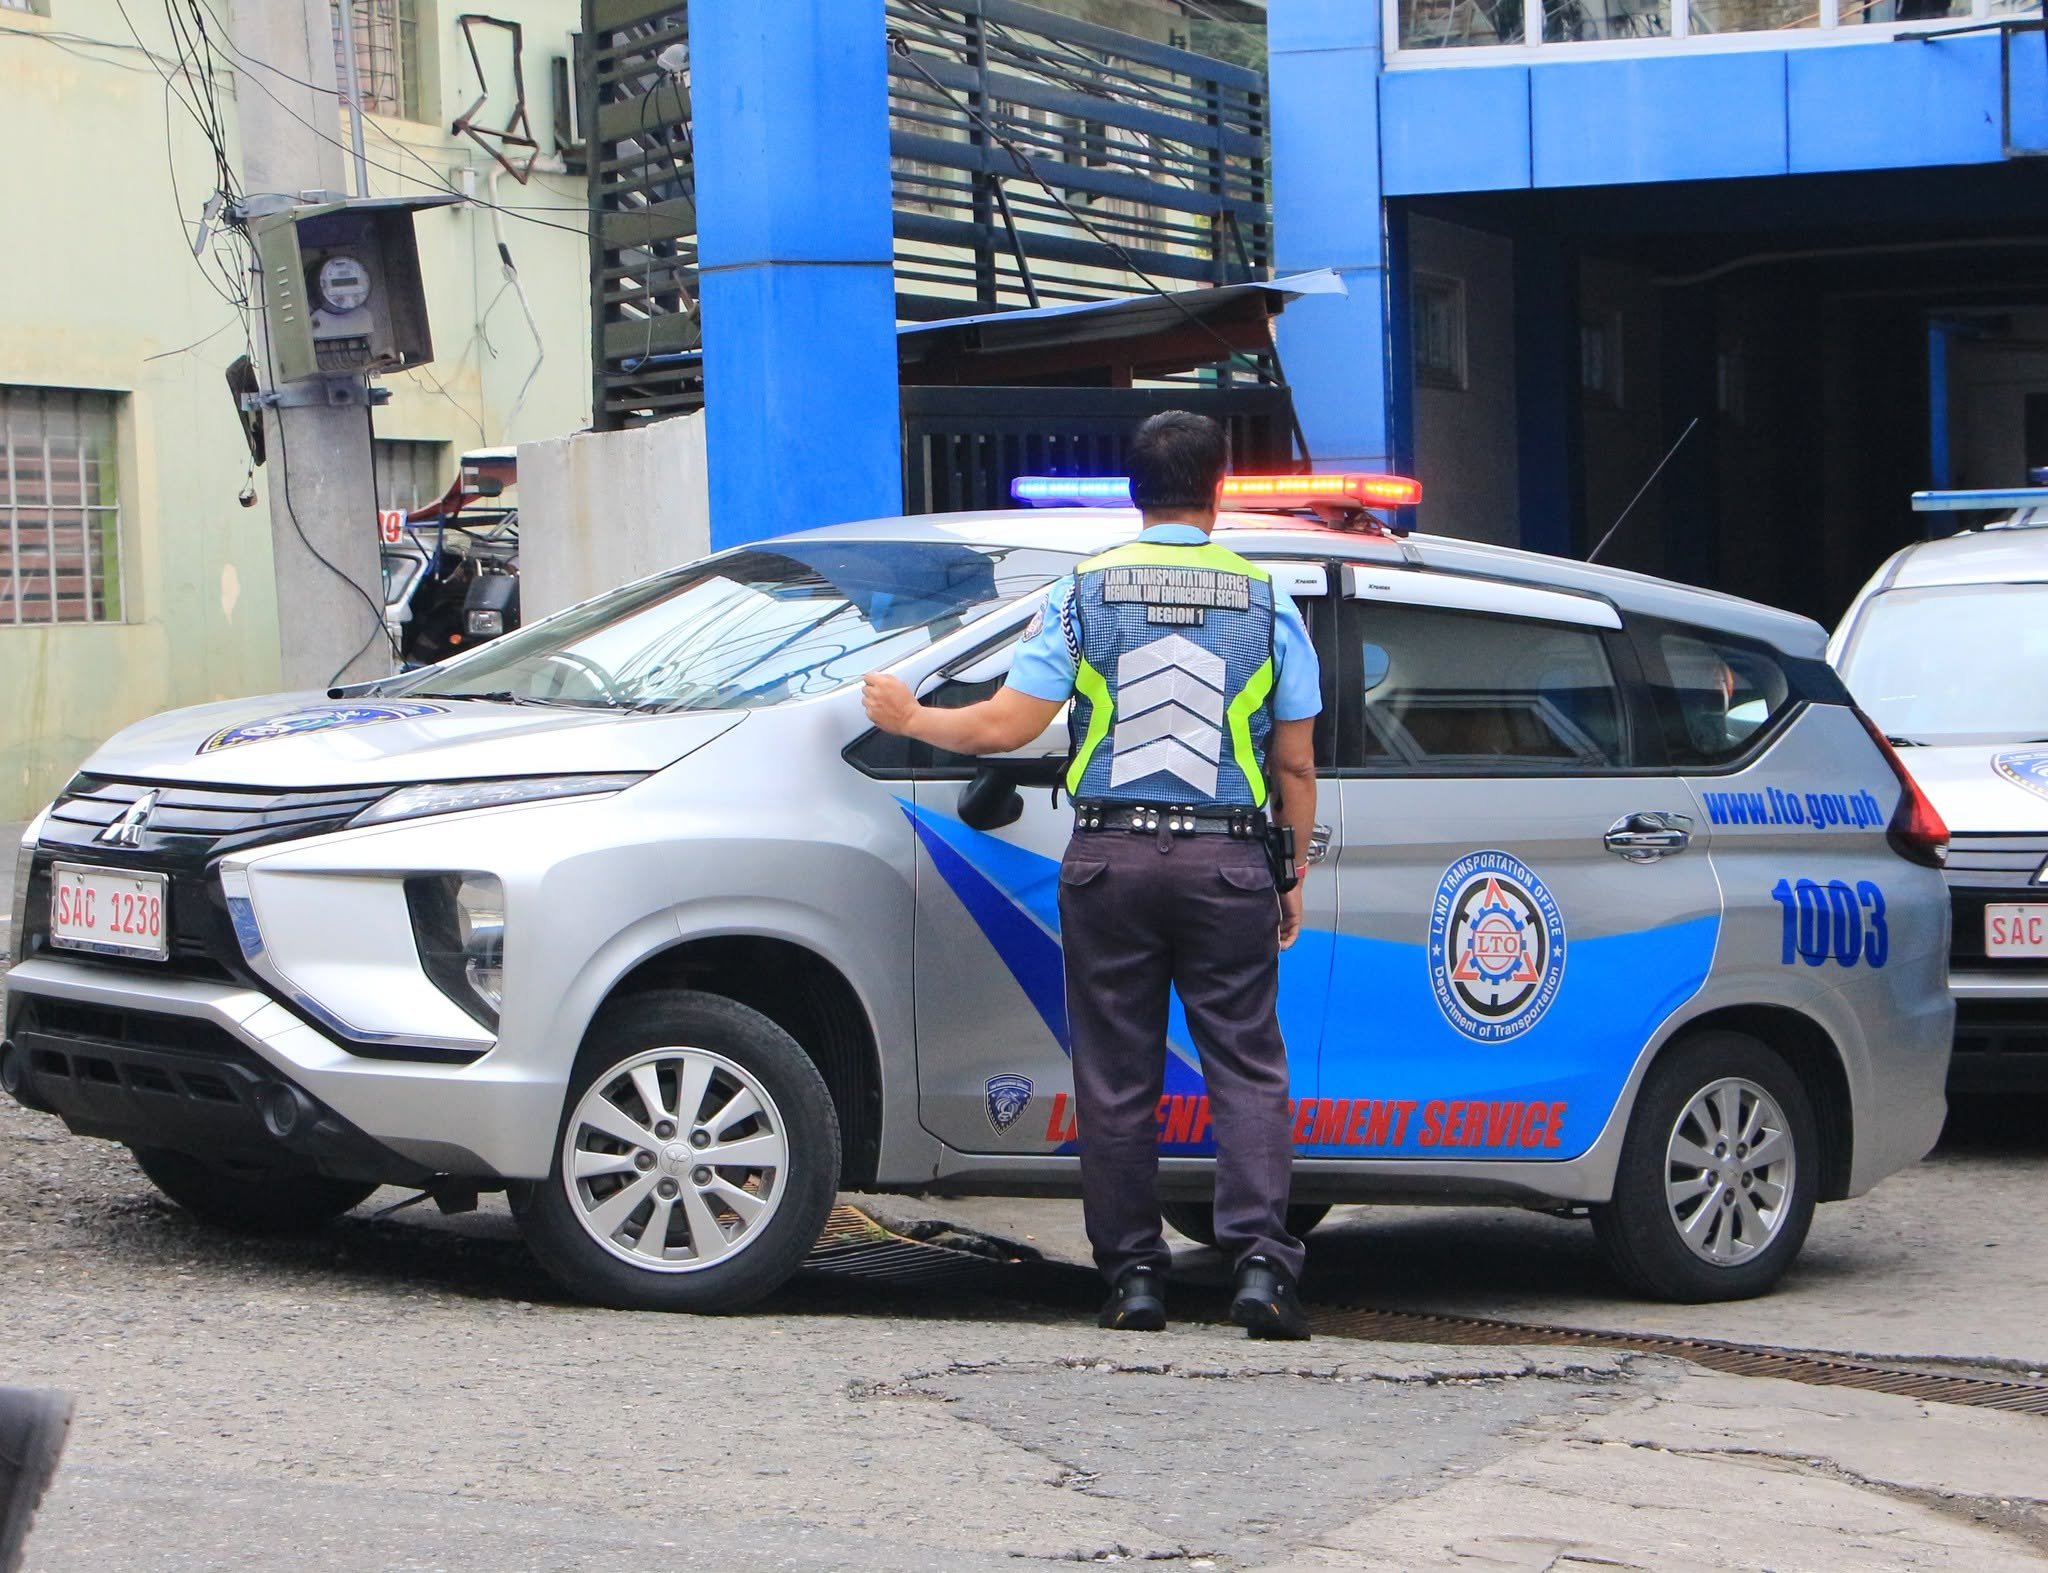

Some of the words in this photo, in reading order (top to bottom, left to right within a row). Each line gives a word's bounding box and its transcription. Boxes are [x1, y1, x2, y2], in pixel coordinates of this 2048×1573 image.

[1104, 569, 1130, 586] LAND
[1130, 568, 1216, 589] TRANSPORTATION
[1216, 572, 1249, 592] OFFICE
[1104, 584, 1142, 602] REGIONAL
[1143, 585, 1161, 603] LAW
[1161, 585, 1216, 606] ENFORCEMENT
[1216, 588, 1249, 609] SECTION
[1147, 606, 1195, 625] REGION
[1196, 608, 1204, 625] 1
[1702, 786, 1884, 830] www.lto.gov.ph
[59, 886, 96, 928] SAC
[110, 892, 160, 936] 1238
[1432, 894, 1450, 935] LAND
[1443, 854, 1534, 893] TRANSPORTATION
[1534, 885, 1562, 938] OFFICE
[1477, 935, 1518, 954] LTO
[1770, 878, 1889, 968] 1003
[1992, 917, 2043, 945] SAC
[1434, 966, 1477, 1033] Department
[1479, 1024, 1491, 1037] of
[1493, 966, 1560, 1037] Transportation
[1418, 1100, 1567, 1148] SERVICE
